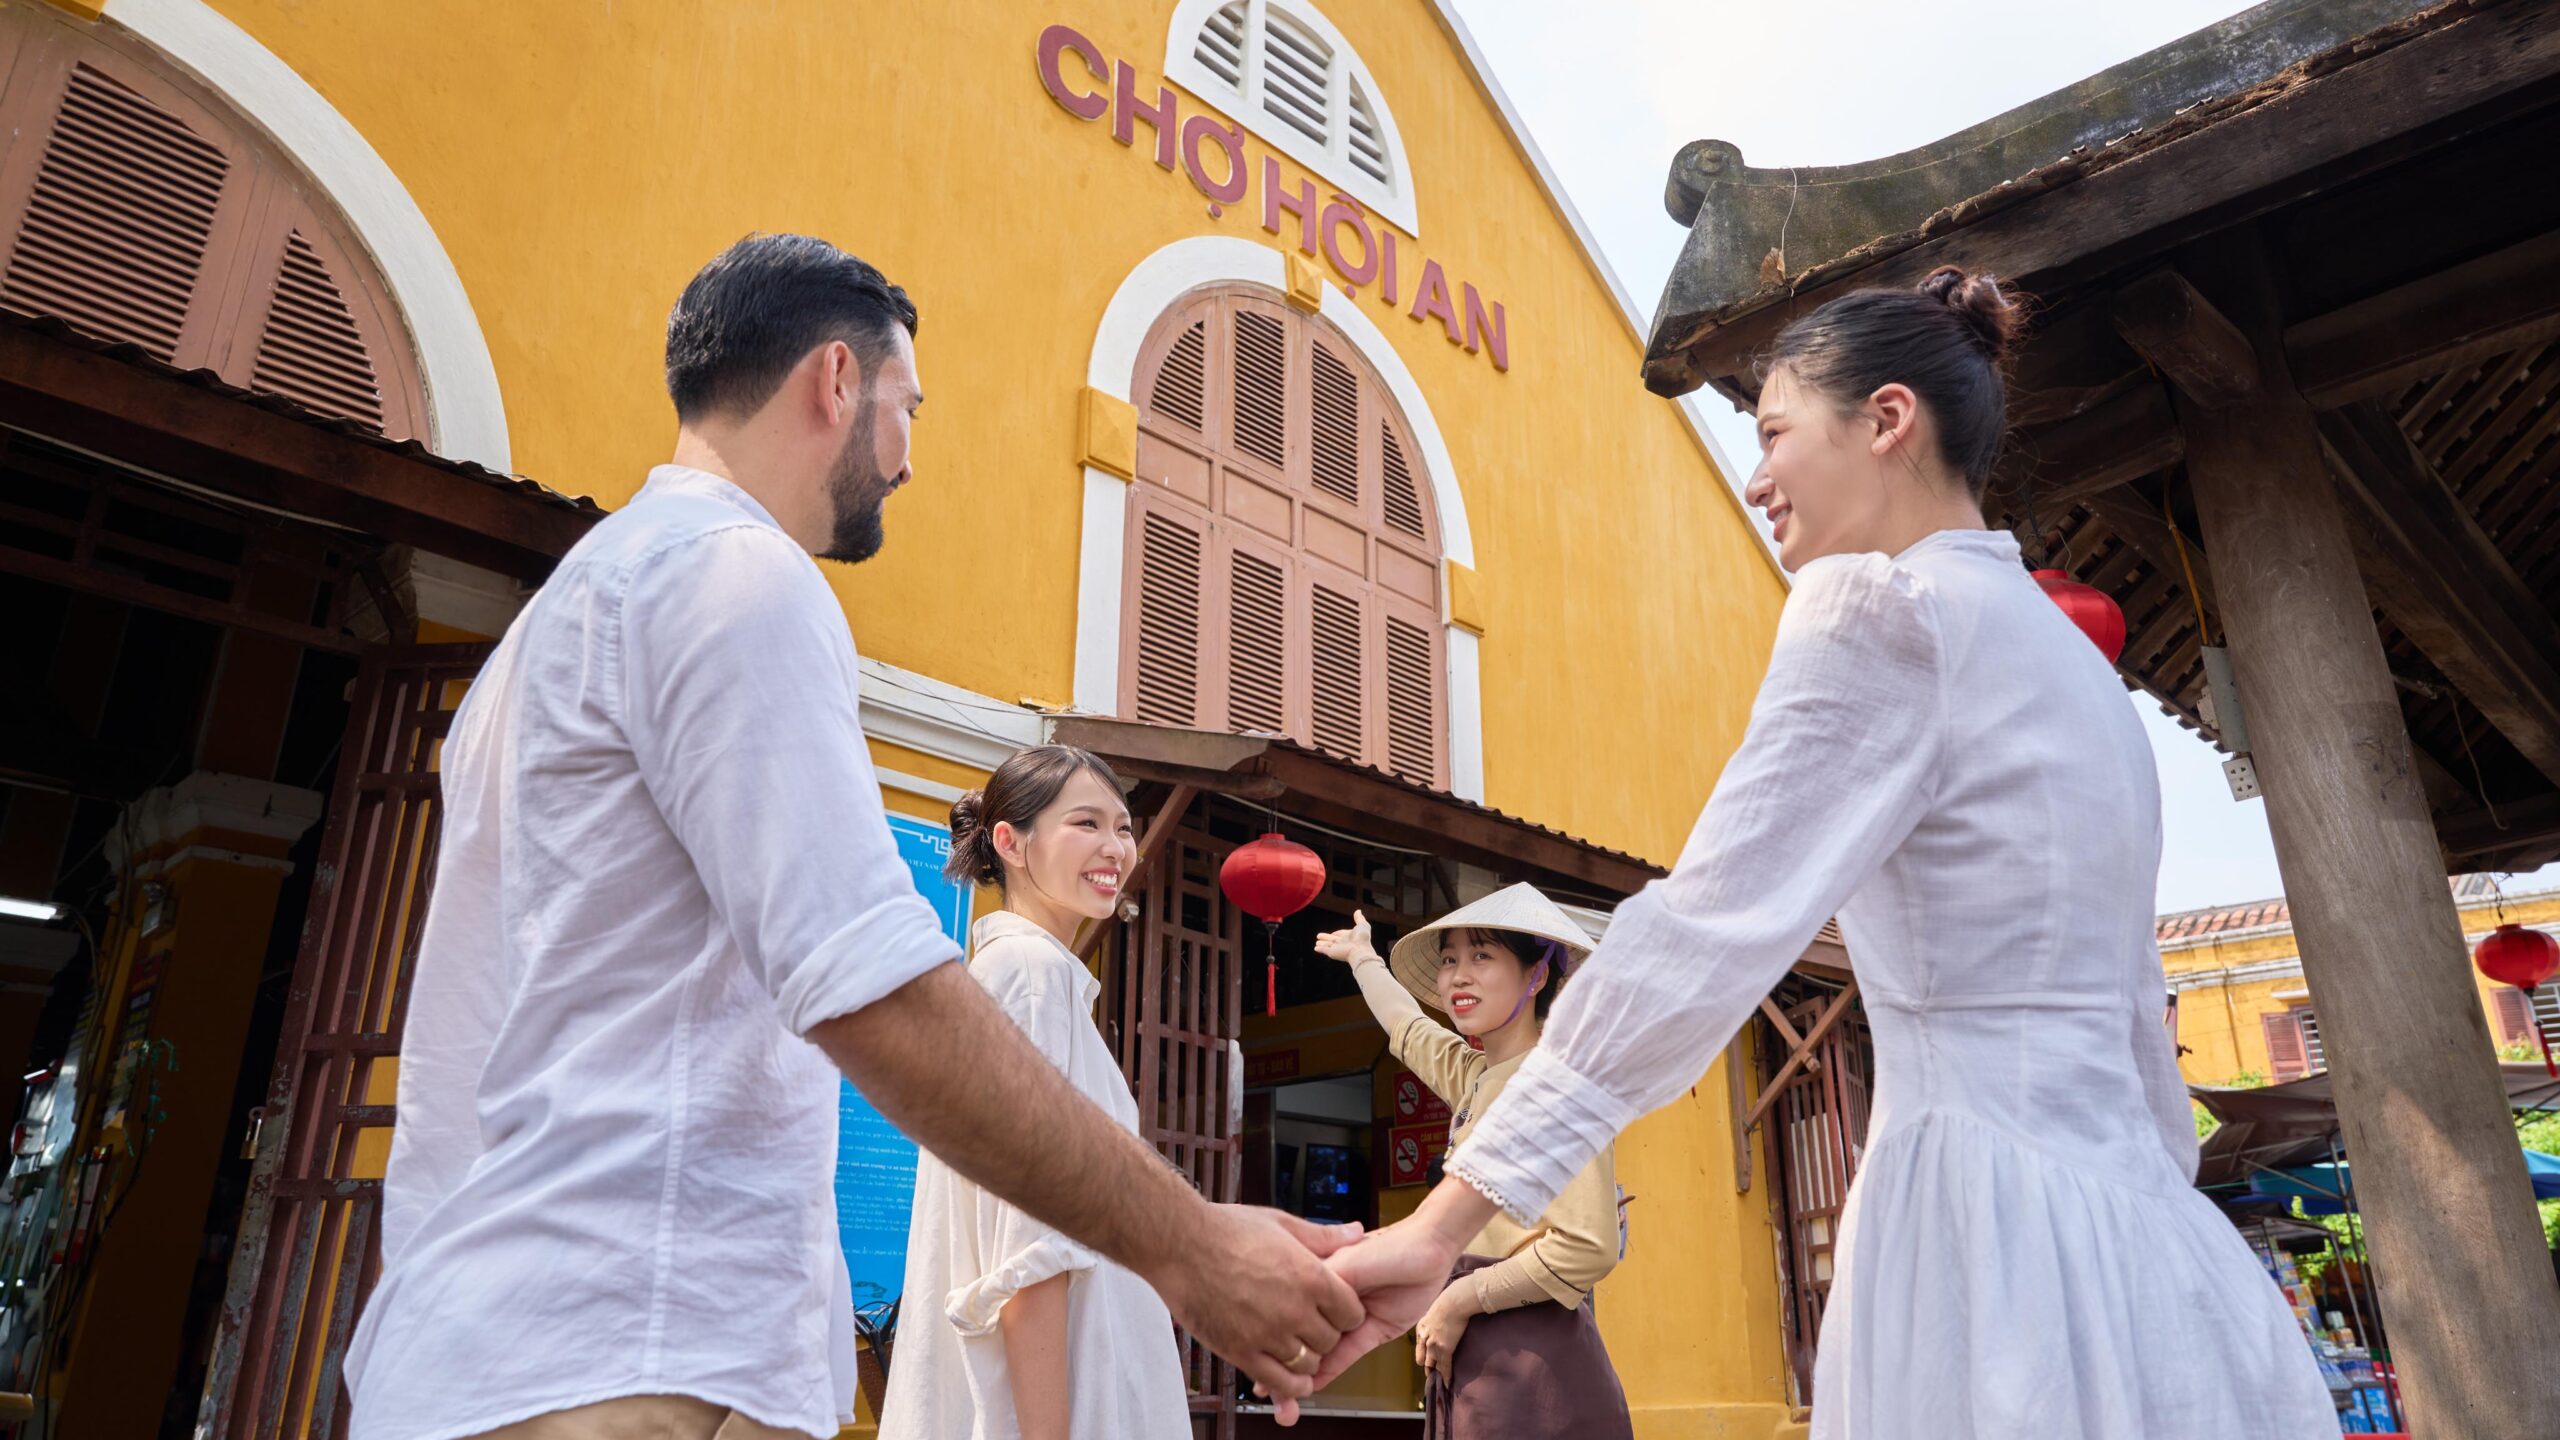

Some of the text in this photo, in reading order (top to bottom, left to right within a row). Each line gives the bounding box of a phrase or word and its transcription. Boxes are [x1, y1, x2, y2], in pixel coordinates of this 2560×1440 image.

[1037, 25, 1509, 373] CHỢ HỘI AN
